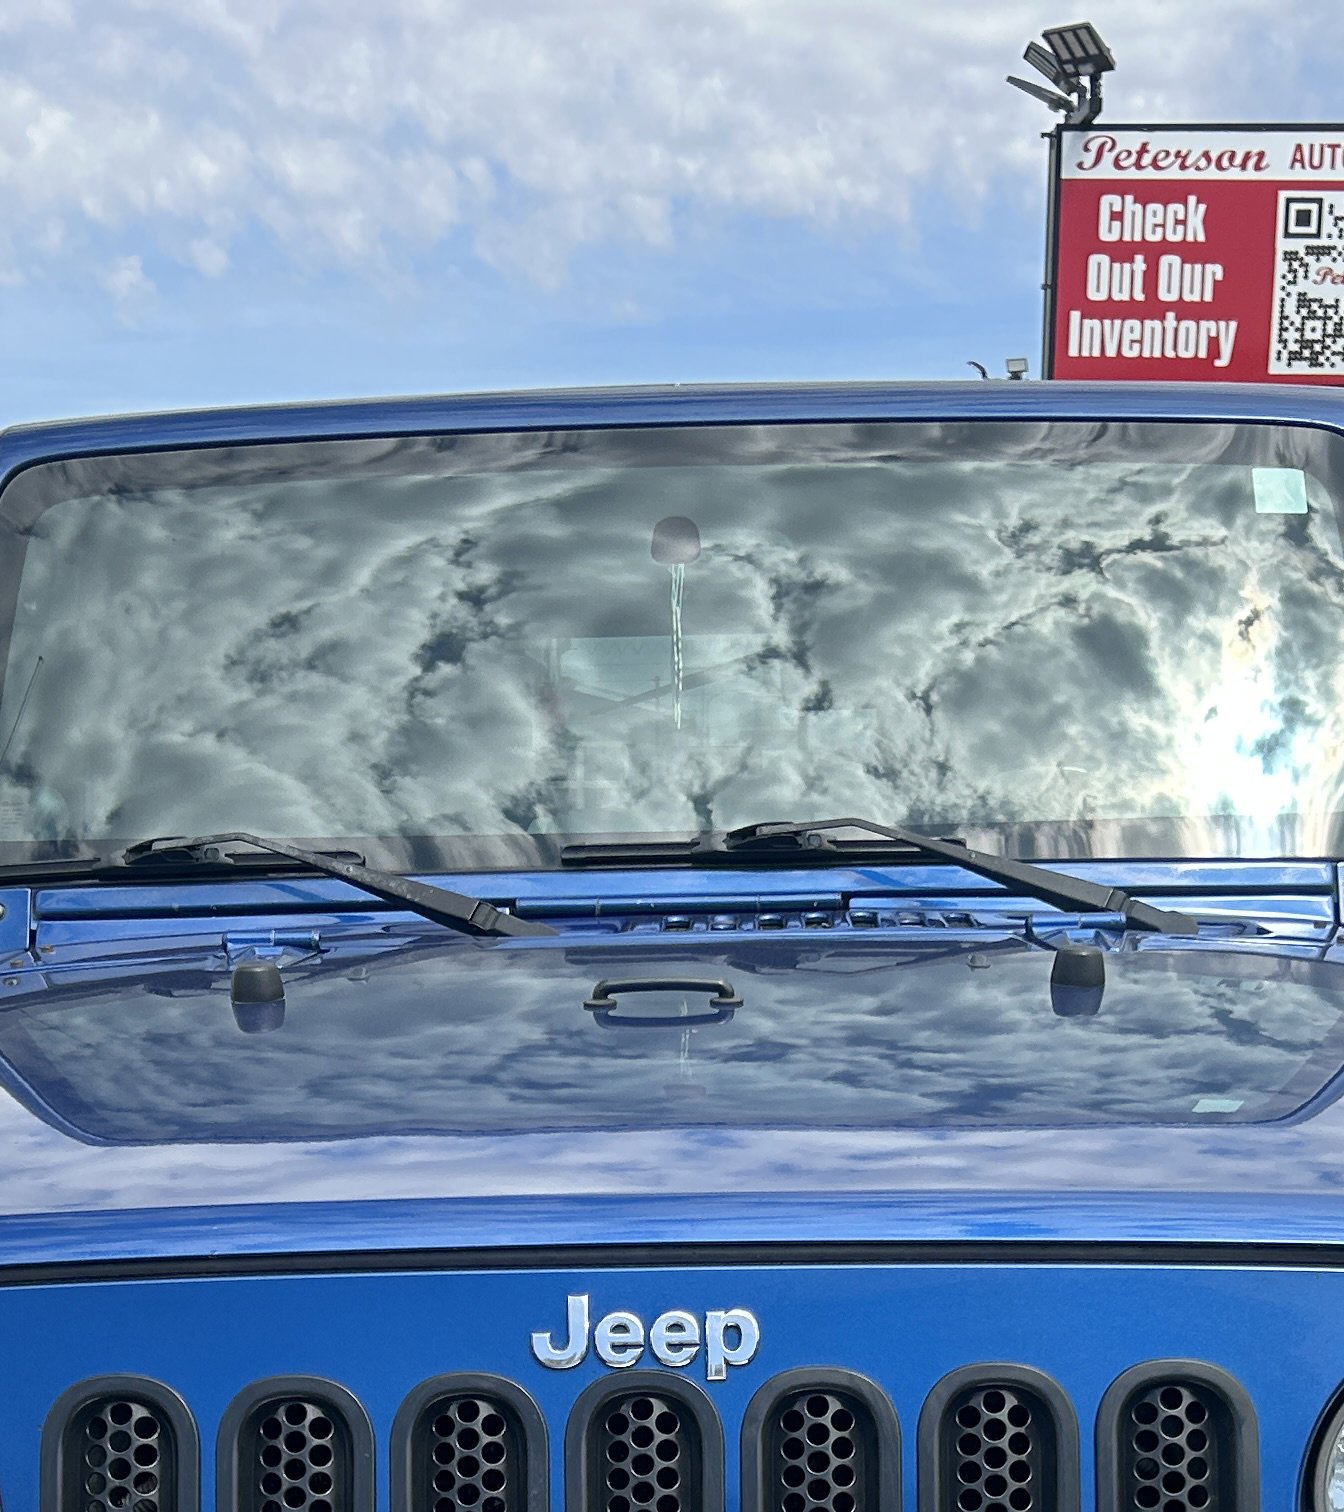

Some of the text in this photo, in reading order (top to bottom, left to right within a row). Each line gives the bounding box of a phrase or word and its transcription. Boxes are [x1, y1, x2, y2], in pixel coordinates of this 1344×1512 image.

[1075, 135, 1270, 172] Peterson
[1098, 194, 1208, 243] Check
[1086, 254, 1224, 302] Out Our
[1068, 310, 1238, 368] Inventory
[531, 1293, 760, 1380] Jeep
